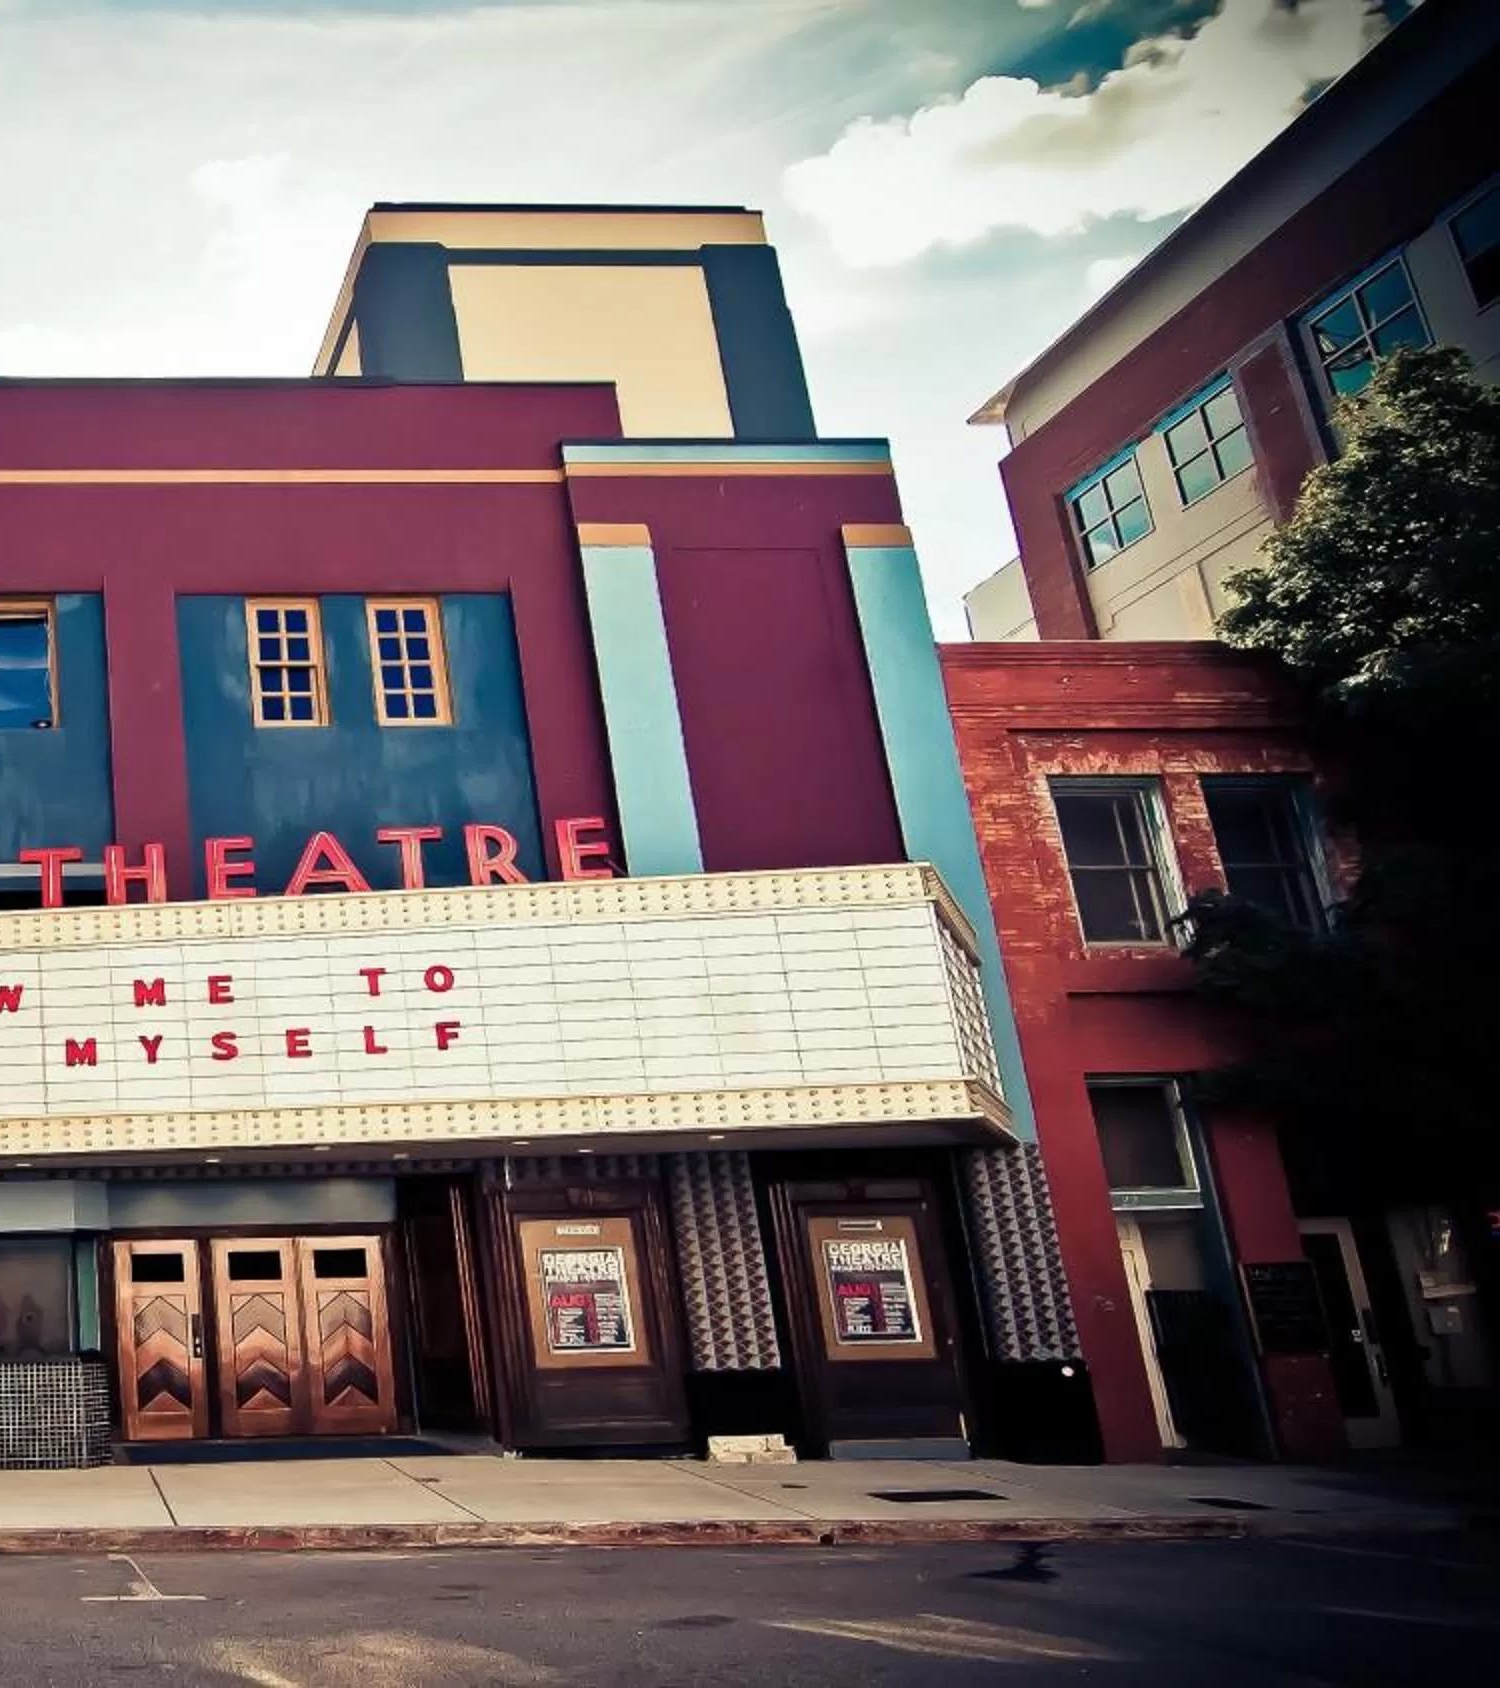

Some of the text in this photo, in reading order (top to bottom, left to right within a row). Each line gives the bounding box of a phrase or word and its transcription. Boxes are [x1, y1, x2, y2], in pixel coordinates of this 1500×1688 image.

[19, 817, 614, 907] THEATRE
[132, 975, 235, 1008] ME
[358, 965, 455, 997] TO
[64, 1021, 461, 1068] MYSELF
